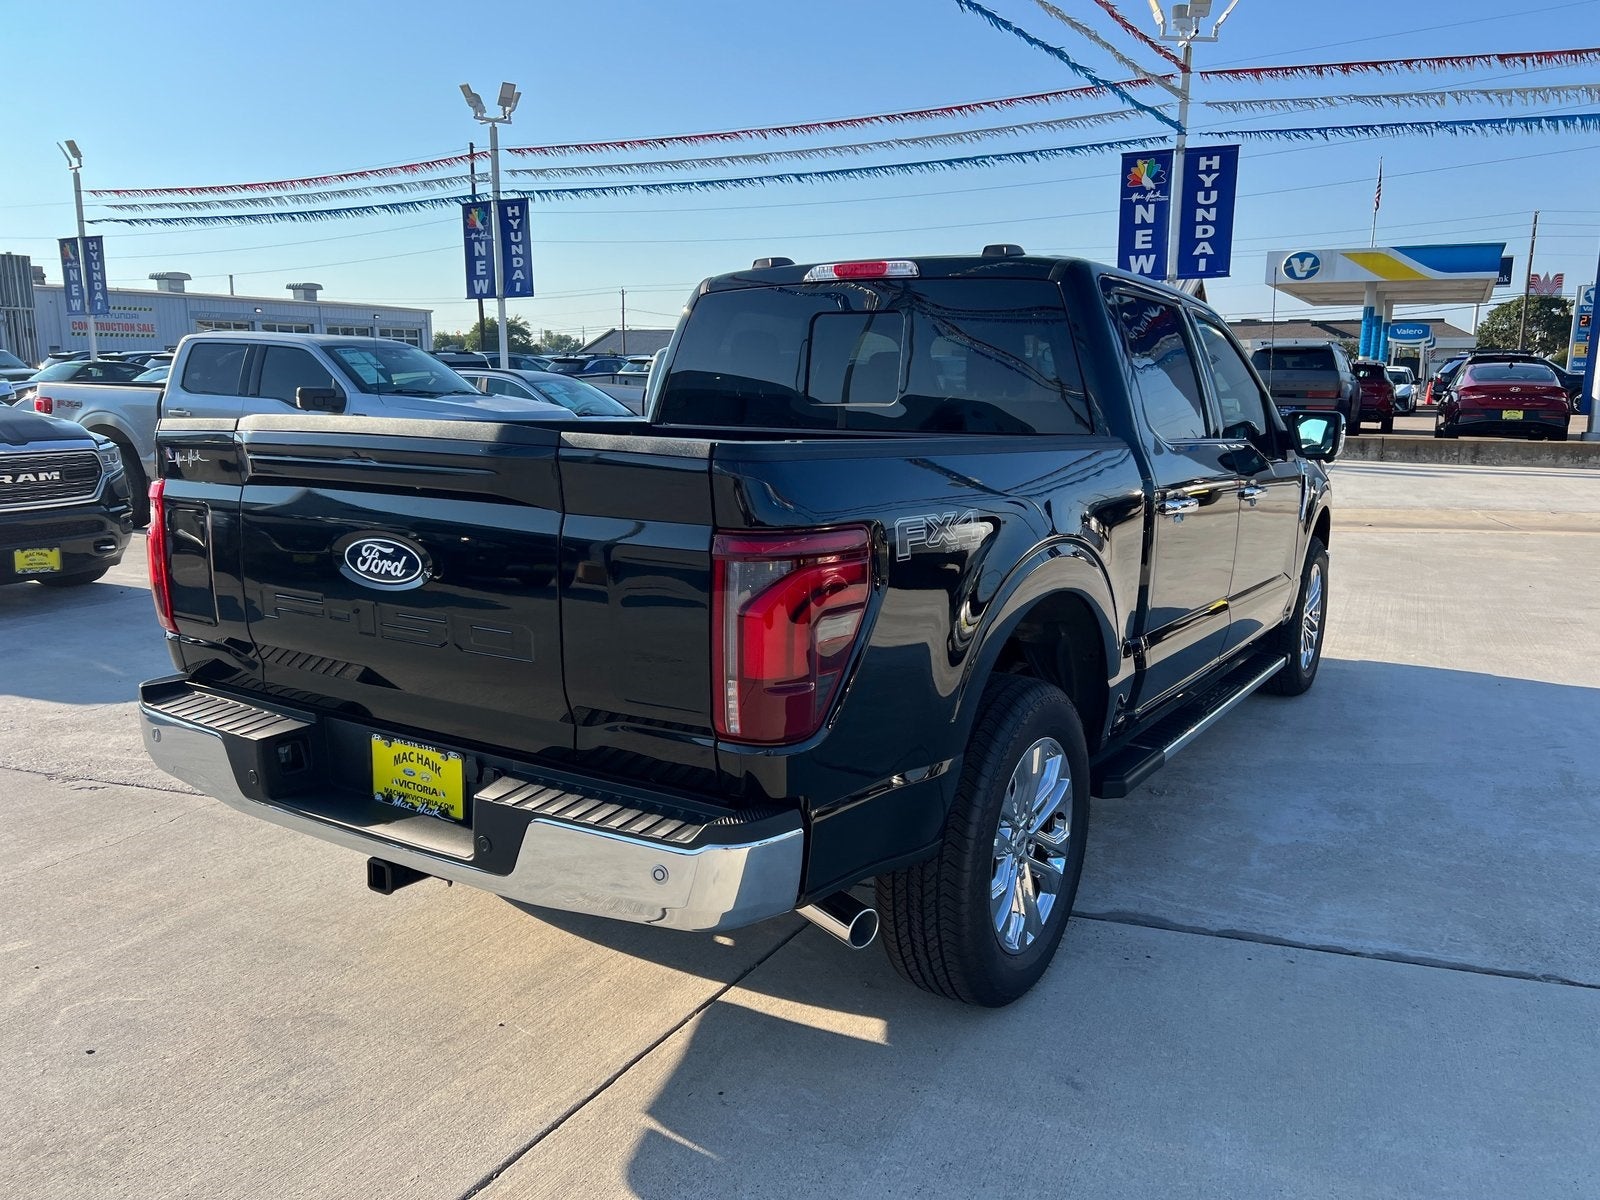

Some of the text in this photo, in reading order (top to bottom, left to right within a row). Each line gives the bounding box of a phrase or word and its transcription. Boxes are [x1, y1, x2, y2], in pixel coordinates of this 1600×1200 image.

[1191, 155, 1221, 272] HYUNDAI
[506, 205, 525, 293] HYUNDAI
[1129, 203, 1157, 274] NEW
[88, 242, 104, 310] HYUNDAI
[473, 241, 489, 295] NEW
[69, 269, 81, 312] NEW
[72, 320, 156, 333] CONTRUCTION SALE
[0, 470, 60, 484] RAM
[893, 508, 981, 563] FX4
[357, 542, 407, 578] Ford
[393, 751, 442, 778] MAC HAIK
[390, 795, 446, 823] Mac Haik
[398, 778, 440, 797] VICTORIA
